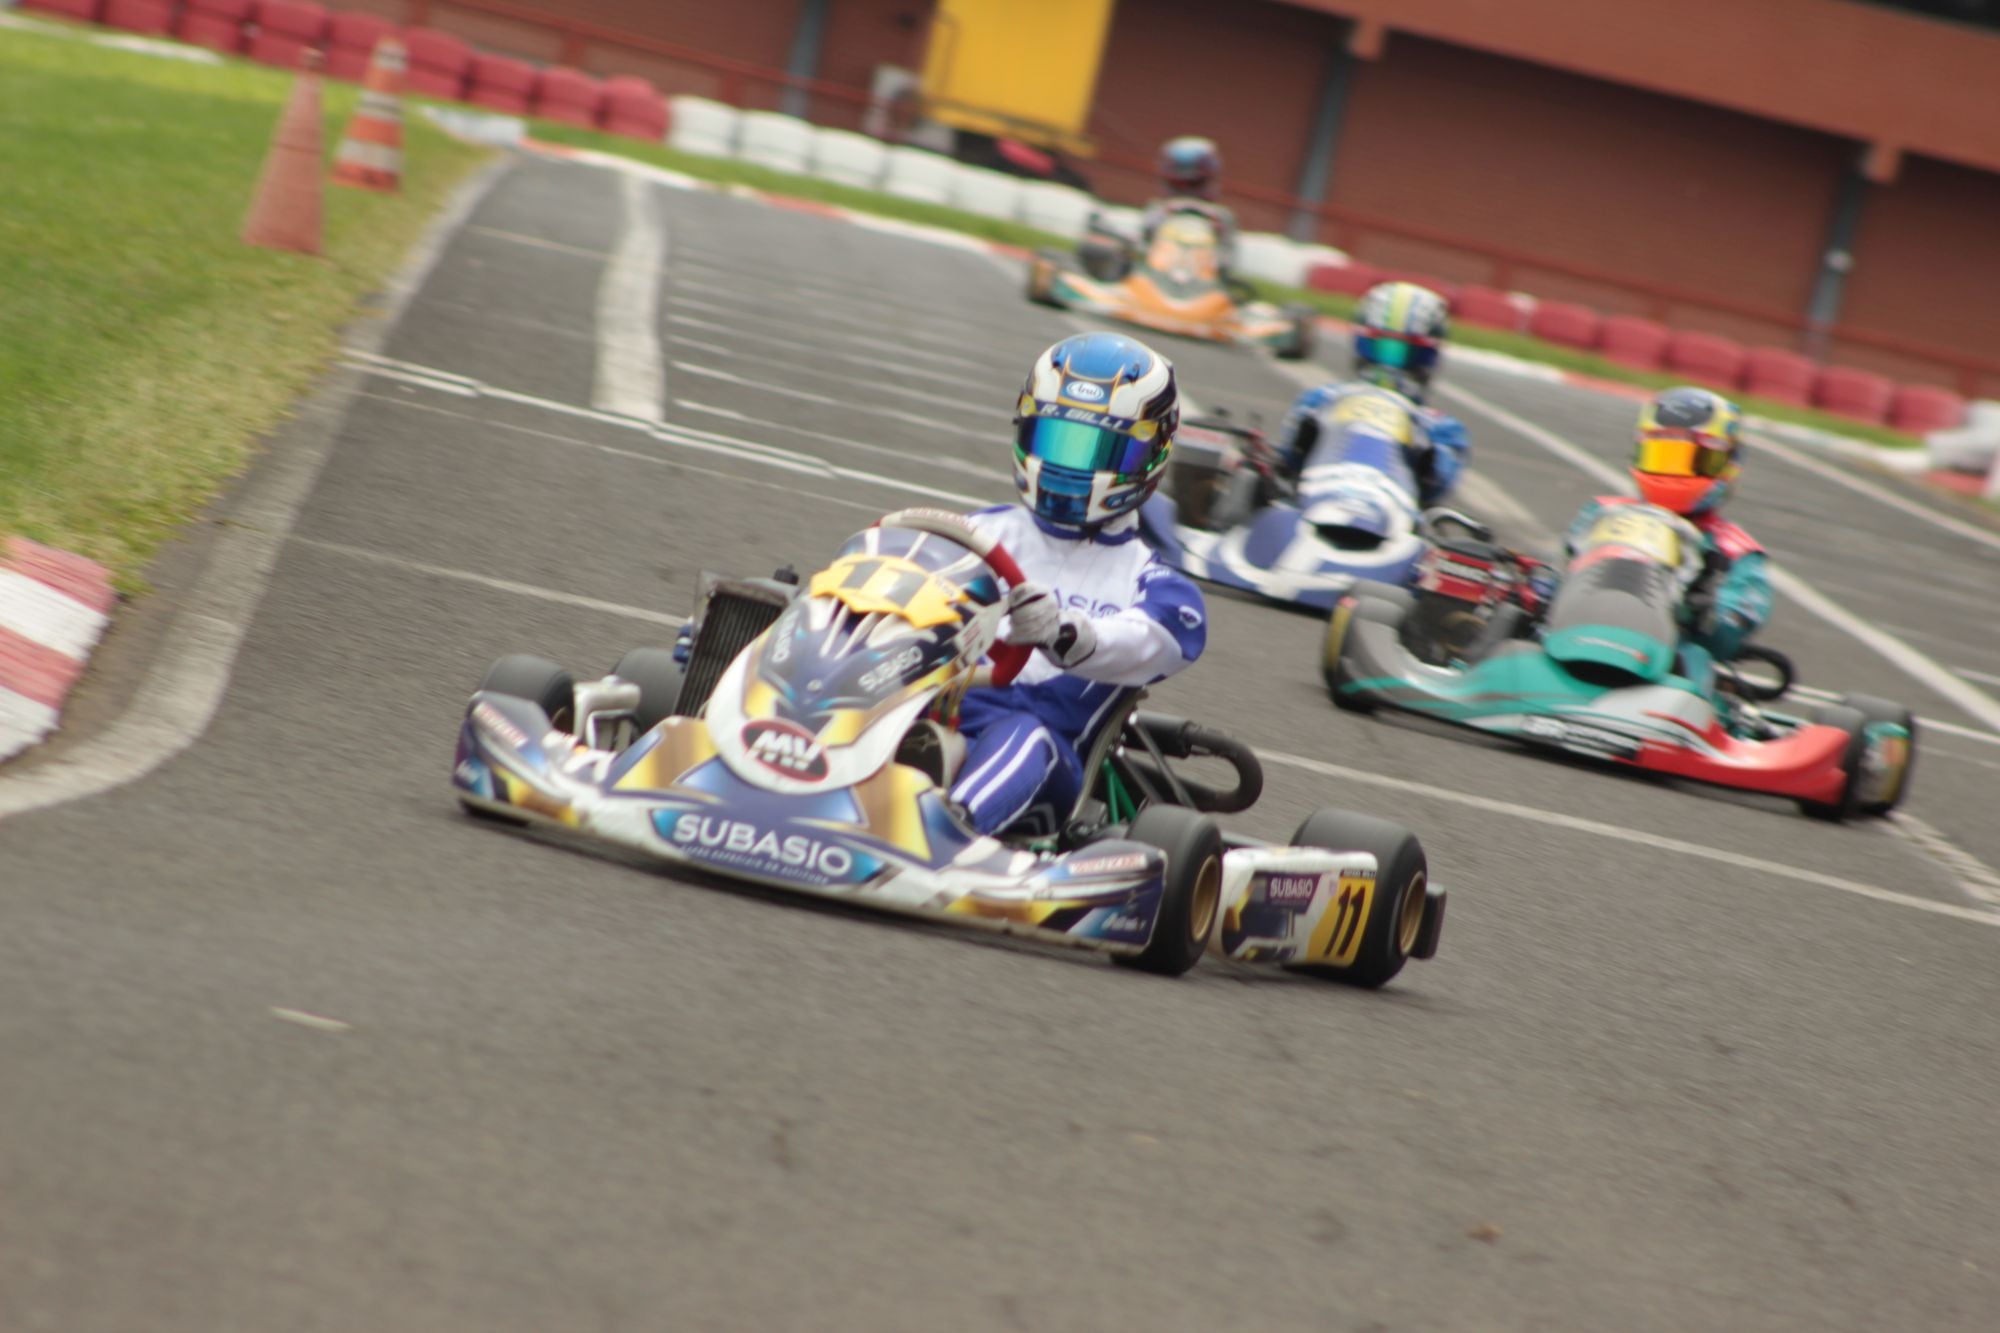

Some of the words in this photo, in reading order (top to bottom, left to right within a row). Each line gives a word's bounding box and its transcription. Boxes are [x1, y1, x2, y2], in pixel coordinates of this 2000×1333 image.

[673, 814, 852, 877] SUBASIO
[1269, 877, 1314, 898] SUBASIO
[1323, 883, 1366, 958] 11
